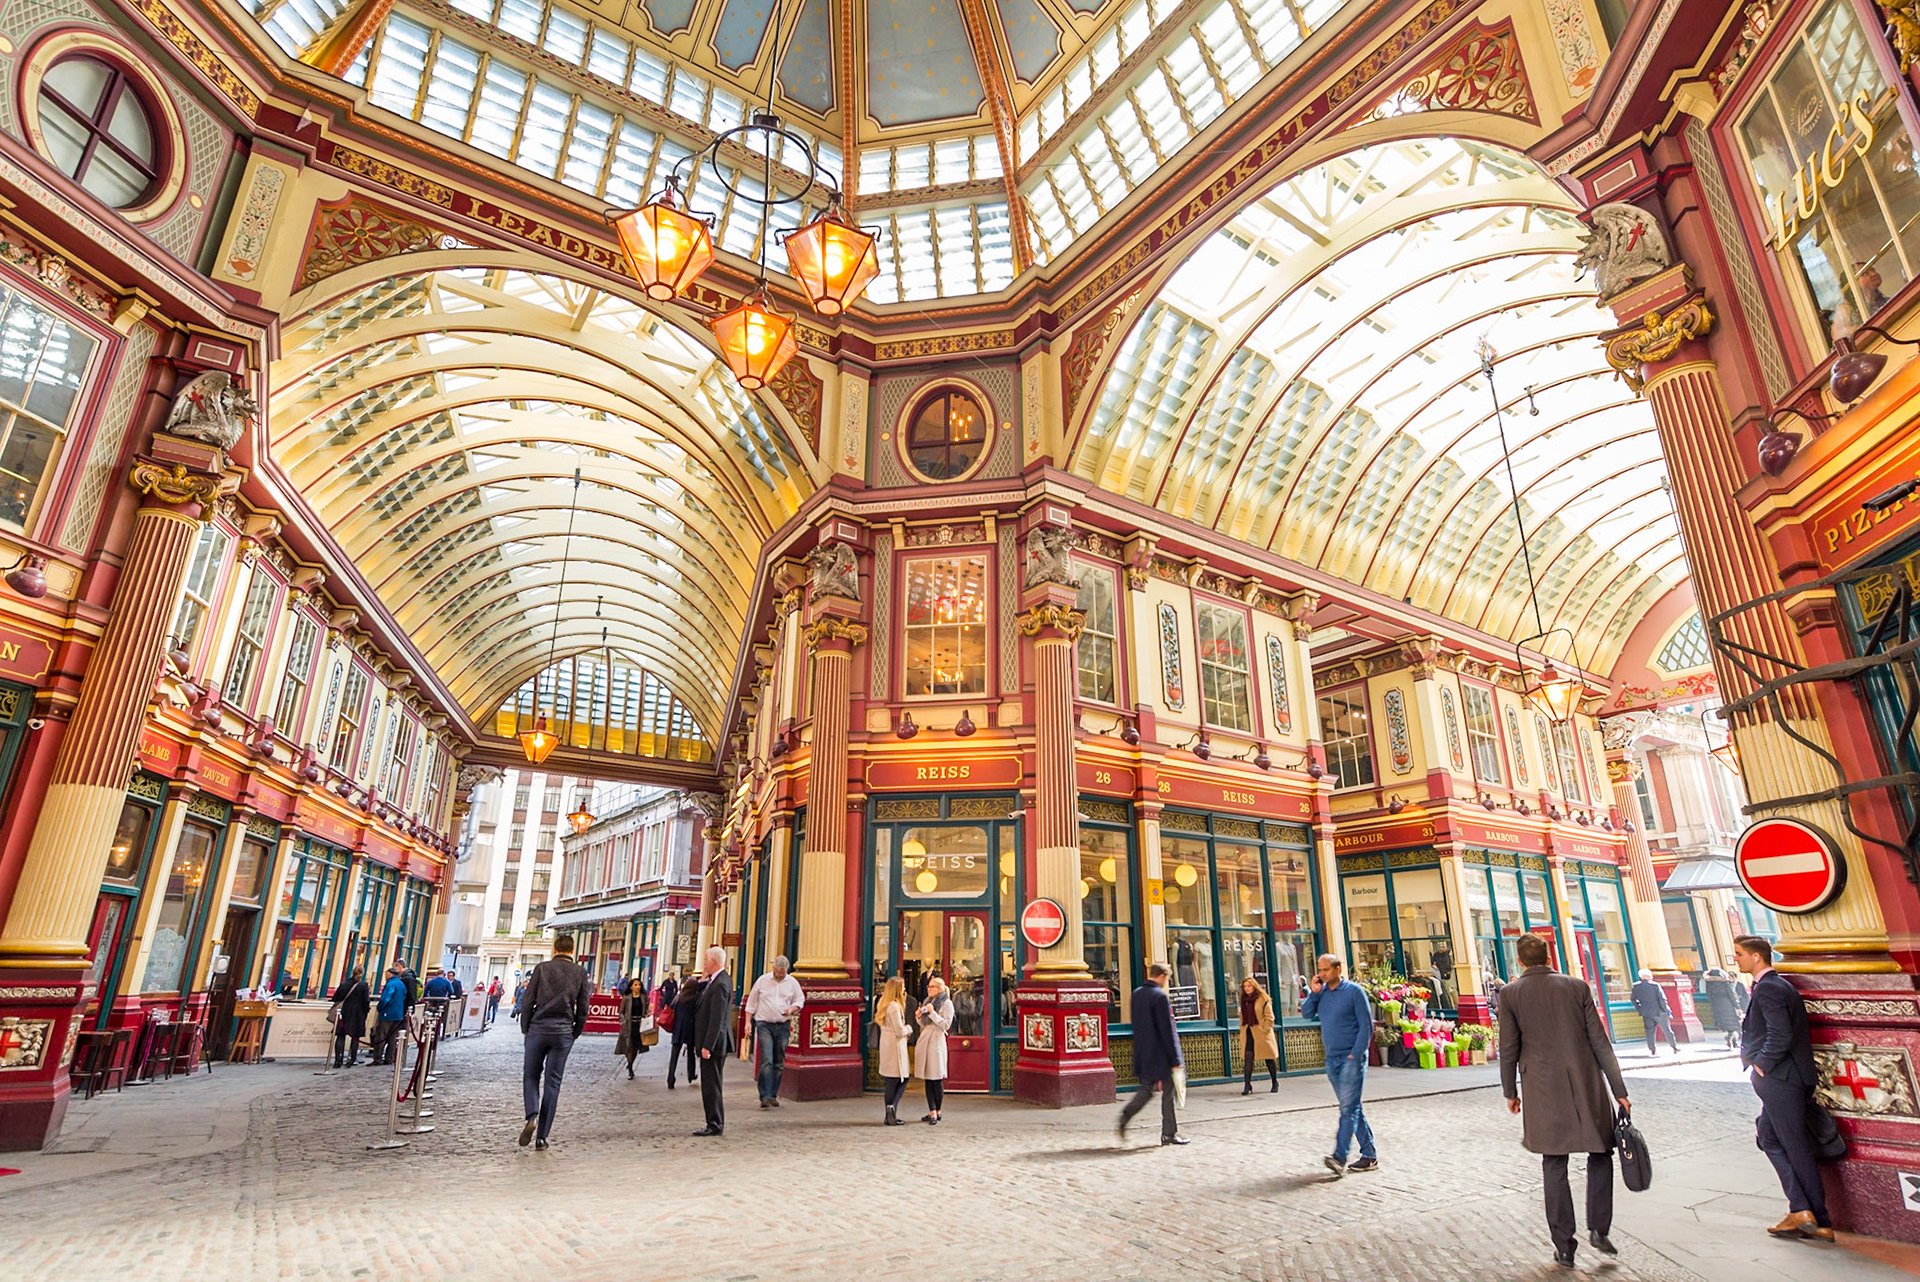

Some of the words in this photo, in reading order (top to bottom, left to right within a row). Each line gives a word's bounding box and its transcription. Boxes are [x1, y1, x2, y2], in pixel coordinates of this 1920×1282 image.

[1159, 106, 1314, 245] MARKET
[1772, 88, 1876, 252] LUC'S
[140, 740, 171, 762] LAMB
[203, 766, 230, 788] TAVERN
[917, 766, 971, 779] REISS
[1096, 771, 1112, 785] 26
[1158, 781, 1171, 793] 26
[1223, 790, 1255, 805] REISS
[1299, 802, 1310, 814] 26
[1334, 833, 1385, 848] ARBOUR
[1422, 827, 1434, 837] 31
[1485, 830, 1520, 844] BARBOUR
[1572, 843, 1602, 856] BARBOUR
[912, 856, 976, 869] REISS
[1351, 887, 1378, 895] Barbour
[1275, 915, 1296, 926] REISS
[1223, 939, 1263, 952] REISS
